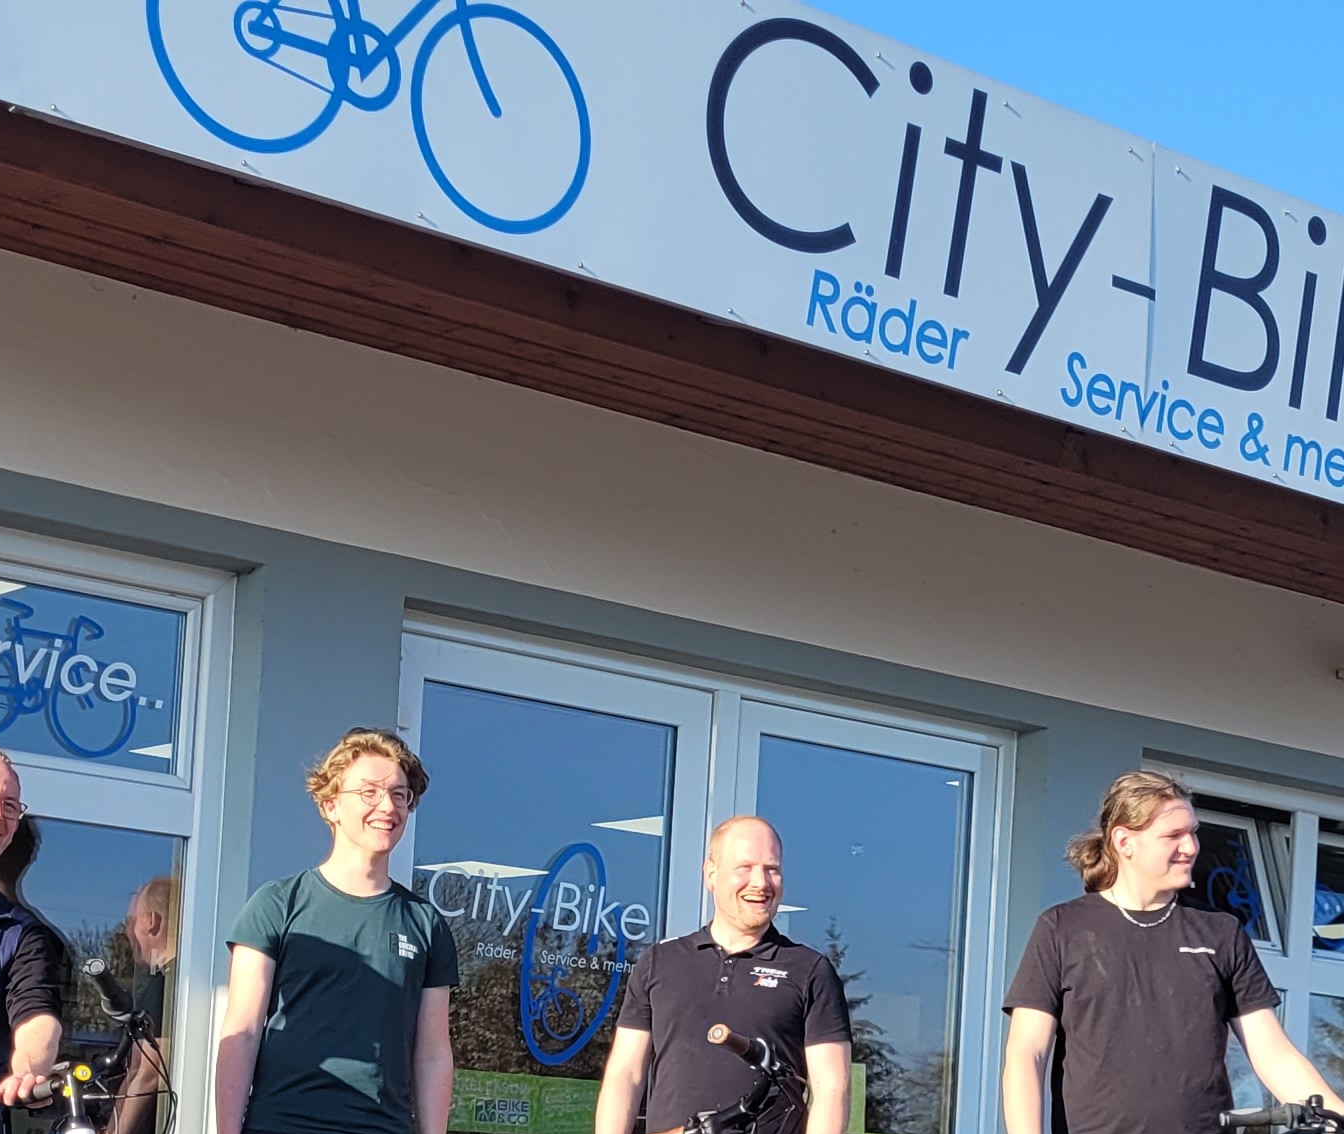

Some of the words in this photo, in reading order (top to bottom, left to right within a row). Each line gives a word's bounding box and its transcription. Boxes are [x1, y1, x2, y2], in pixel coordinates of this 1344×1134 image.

[806, 268, 971, 373] Räder
[1059, 351, 1223, 452] Service
[1239, 412, 1271, 465] &
[428, 866, 650, 942] City-Bike
[476, 942, 517, 961] Räder
[540, 950, 586, 971] Service
[590, 956, 599, 971] &
[497, 1099, 530, 1113] BIKE
